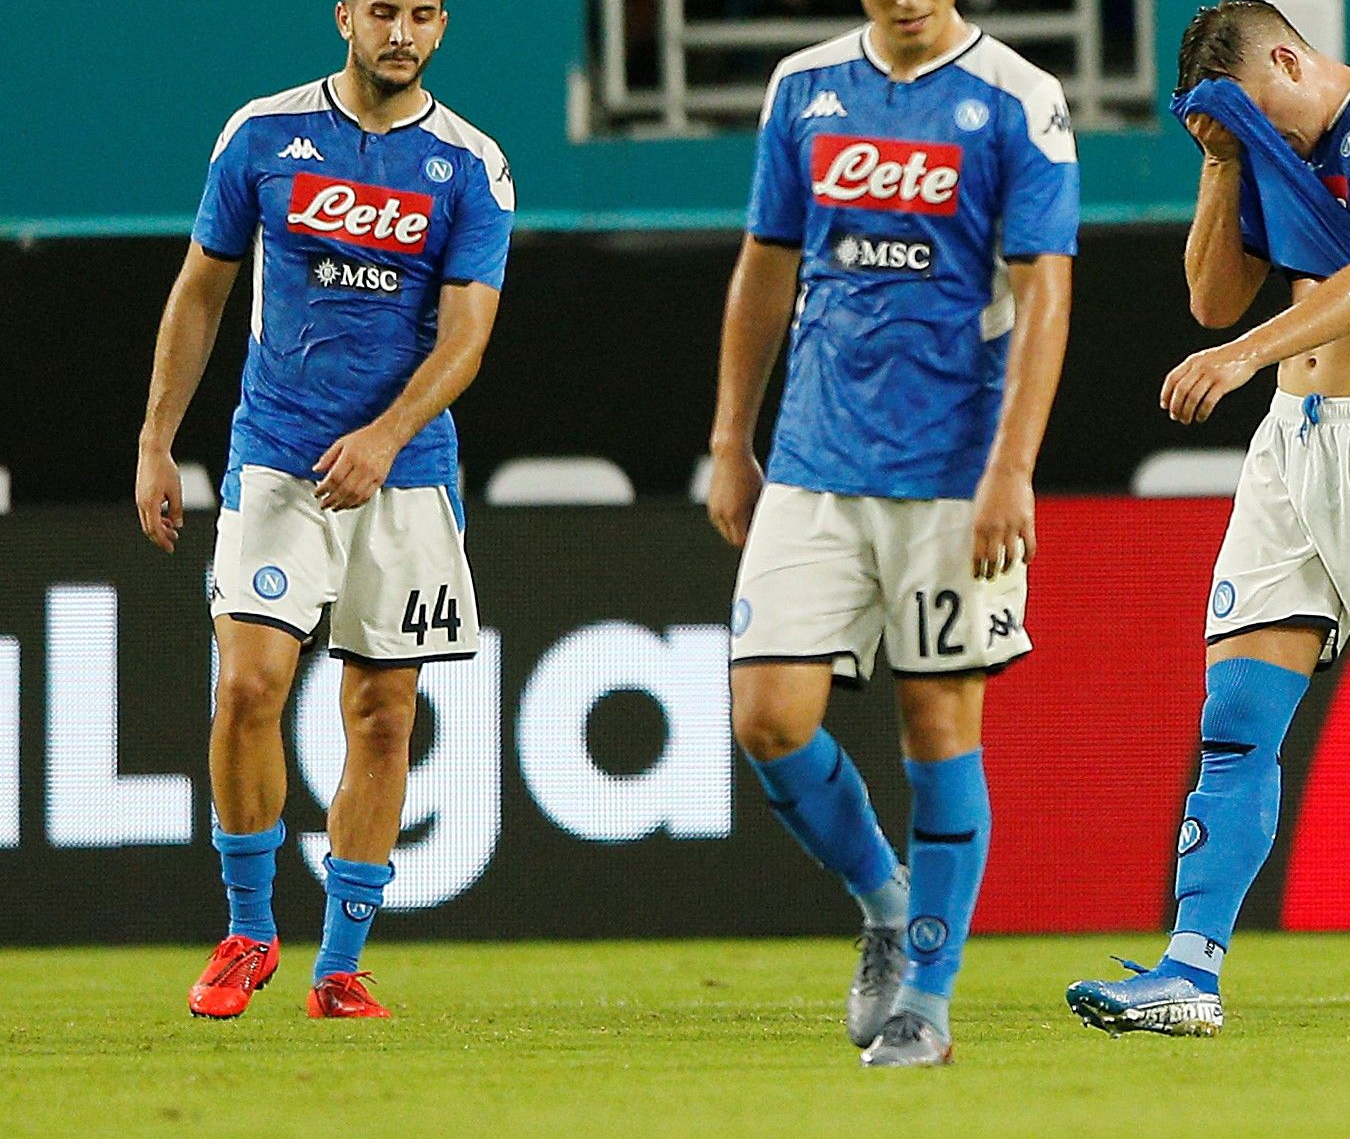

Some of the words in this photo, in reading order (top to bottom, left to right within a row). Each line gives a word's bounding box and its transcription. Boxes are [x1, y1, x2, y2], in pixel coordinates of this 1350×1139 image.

[812, 142, 959, 204] Lete
[288, 185, 429, 244] Lete
[340, 264, 399, 292] MSC
[861, 239, 931, 269] MSC
[401, 584, 461, 646] 44
[916, 589, 964, 657] 12
[0, 561, 734, 913] Lga
